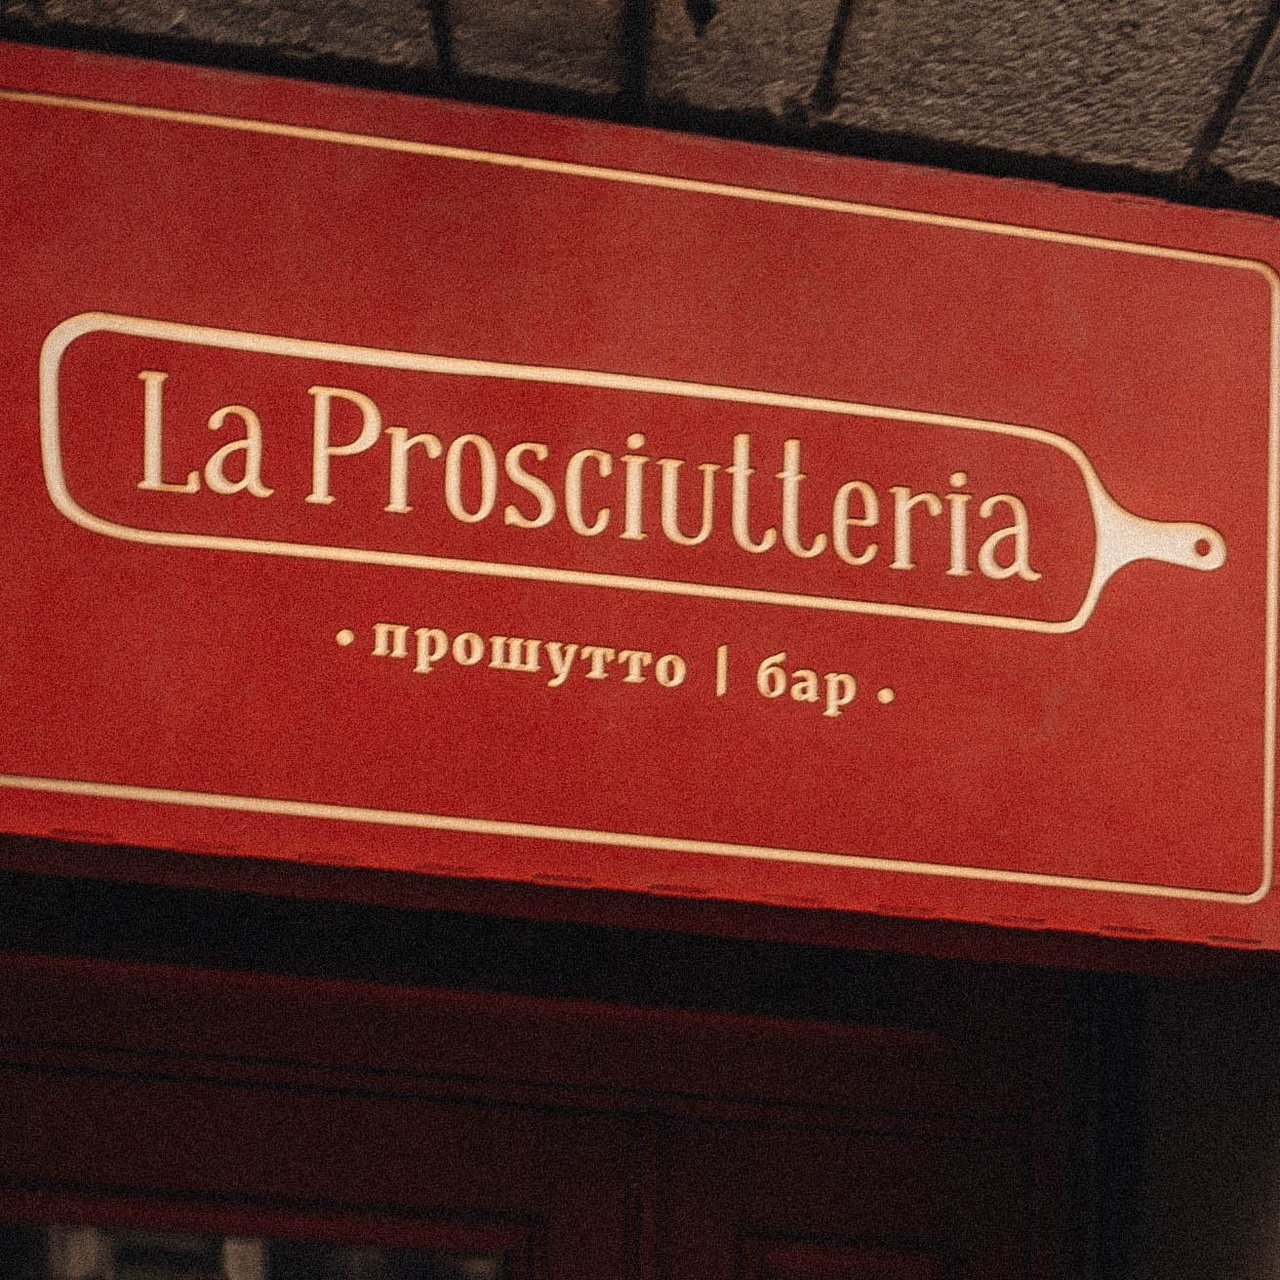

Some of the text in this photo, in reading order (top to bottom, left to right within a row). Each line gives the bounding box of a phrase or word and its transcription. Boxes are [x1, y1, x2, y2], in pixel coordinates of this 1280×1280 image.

[138, 371, 1043, 582] La Prosciutteria
[372, 622, 858, 718] прошутто бар
